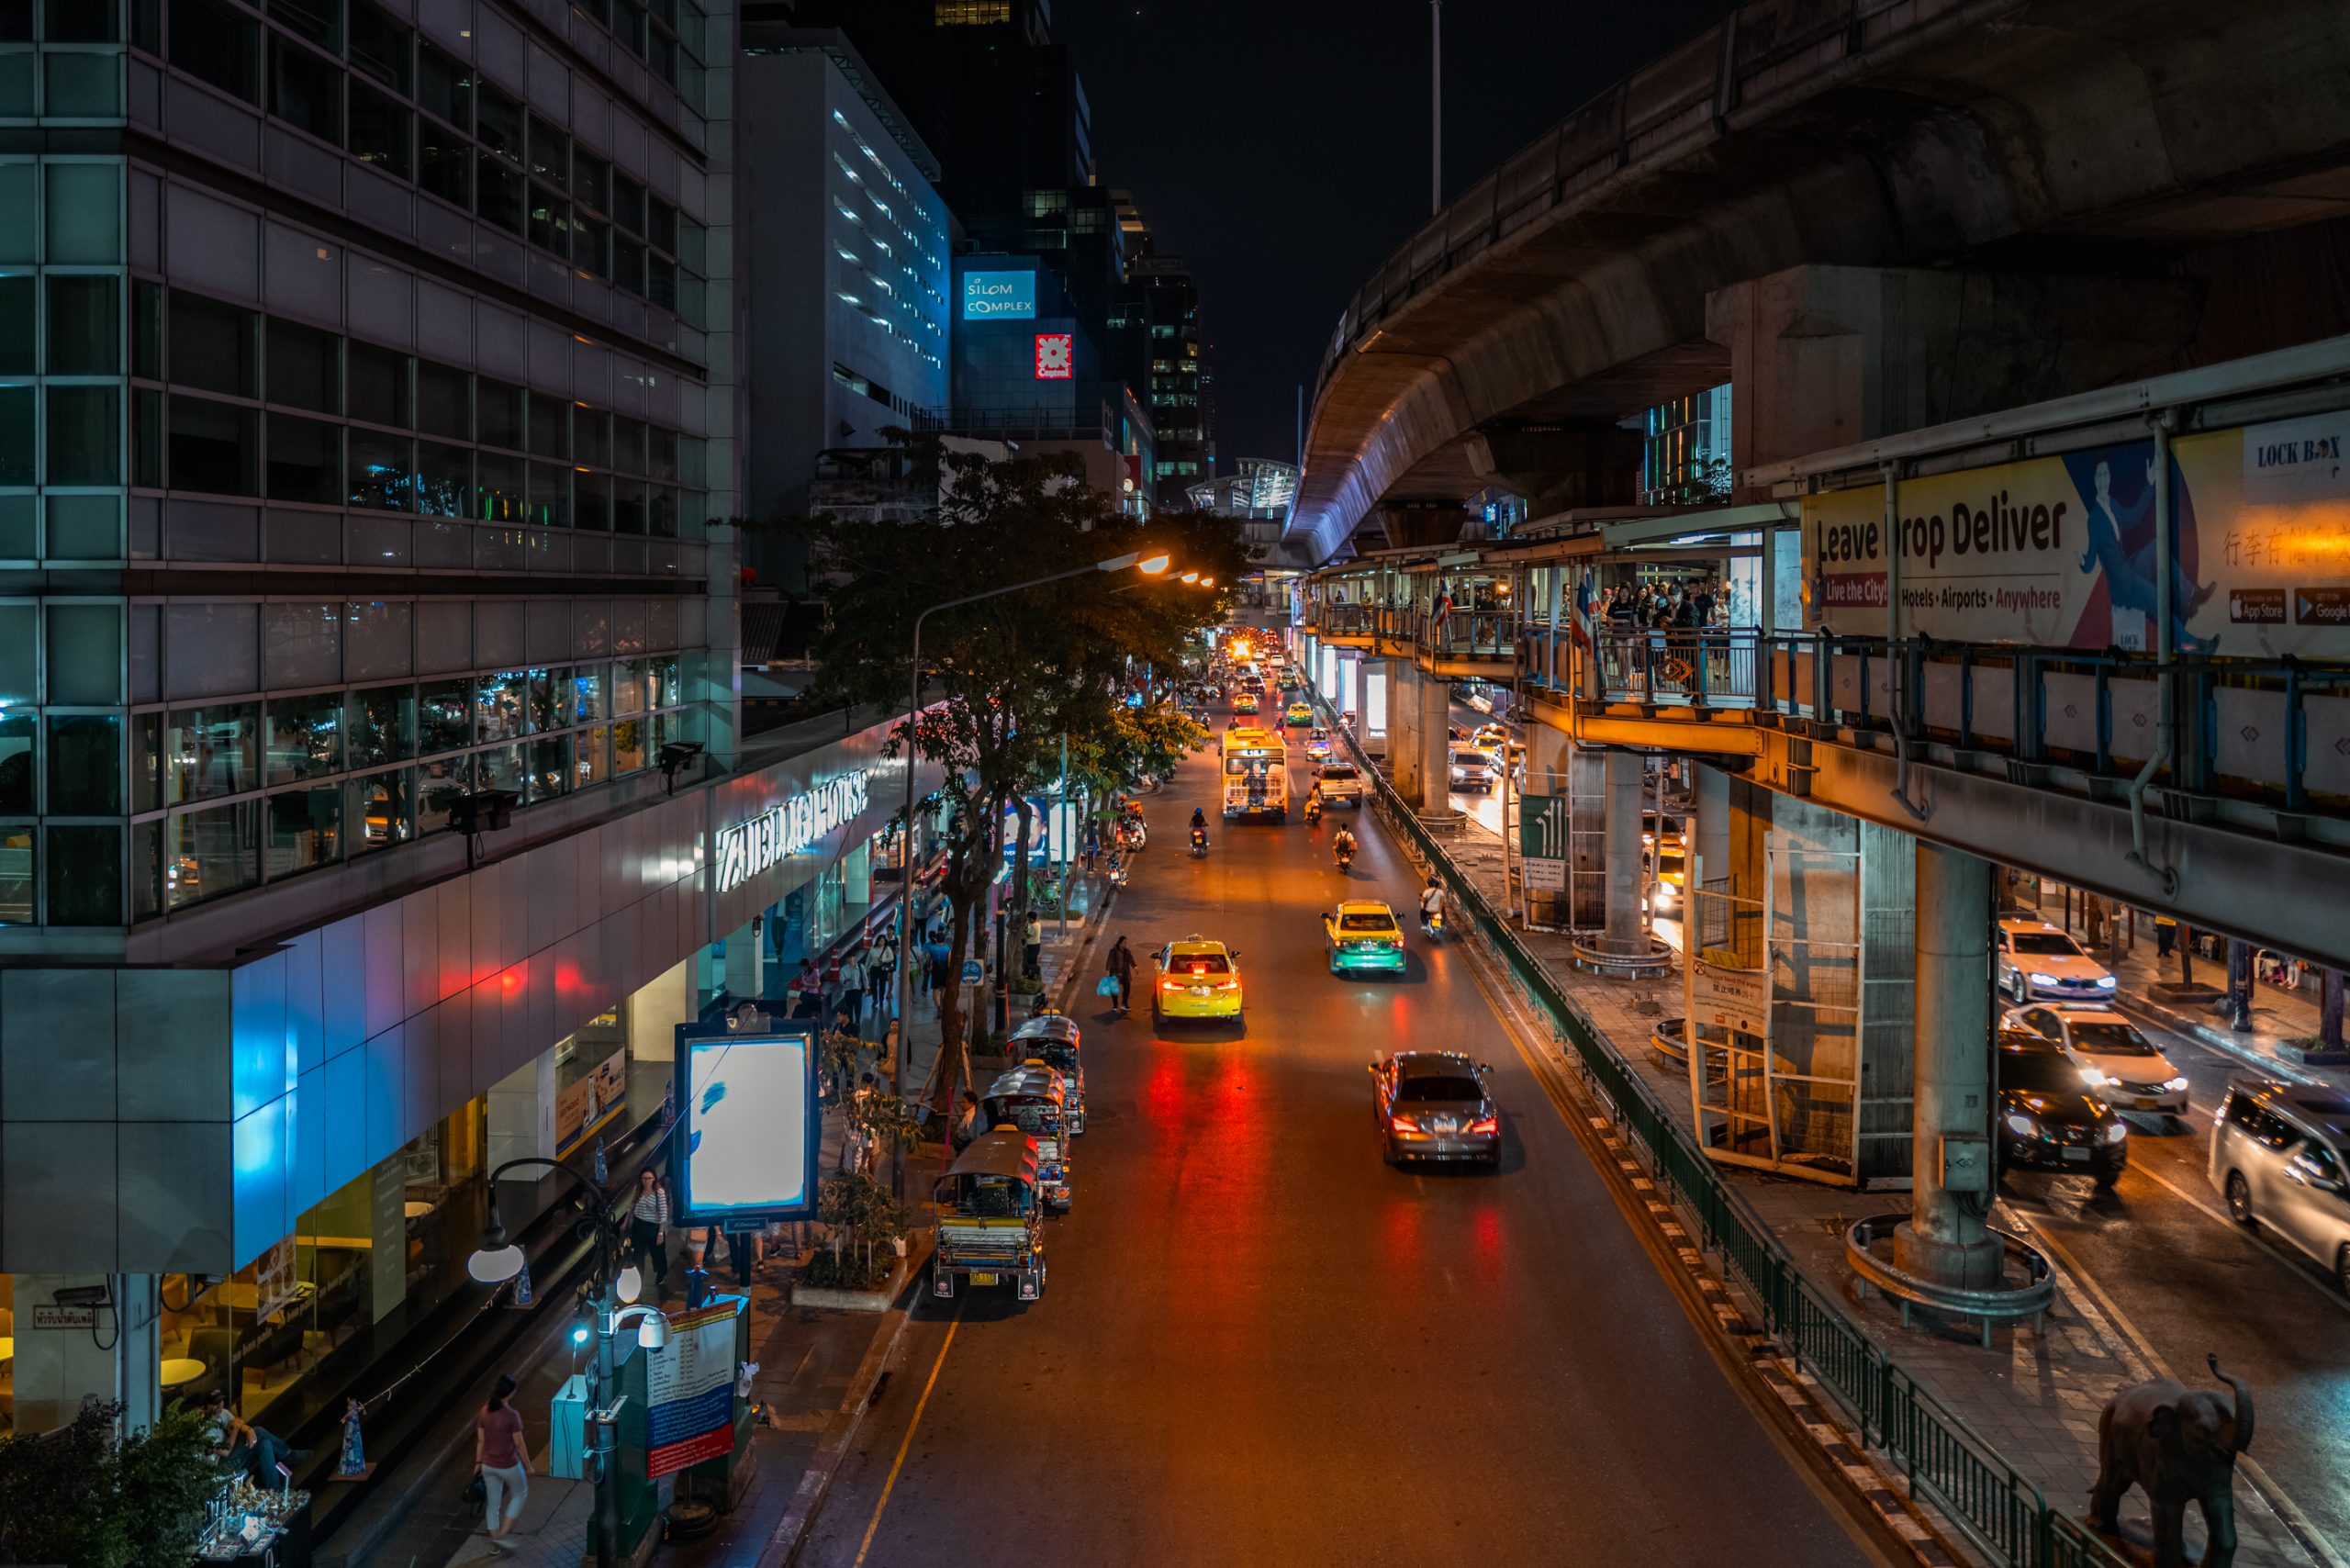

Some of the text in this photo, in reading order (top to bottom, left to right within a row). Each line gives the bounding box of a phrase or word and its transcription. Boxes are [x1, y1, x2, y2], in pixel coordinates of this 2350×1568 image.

[968, 278, 1013, 295] SILOM
[968, 300, 1032, 313] COMPLEX
[2258, 442, 2299, 467] LOCK
[1817, 520, 1878, 562] Leave
[1953, 489, 2066, 555] Deliver
[1826, 580, 1846, 602] Live
[1848, 580, 1863, 602] the
[1902, 586, 2062, 613] Hotels Airports Anywhere
[2243, 603, 2283, 620] App Store
[2316, 603, 2347, 622] Google
